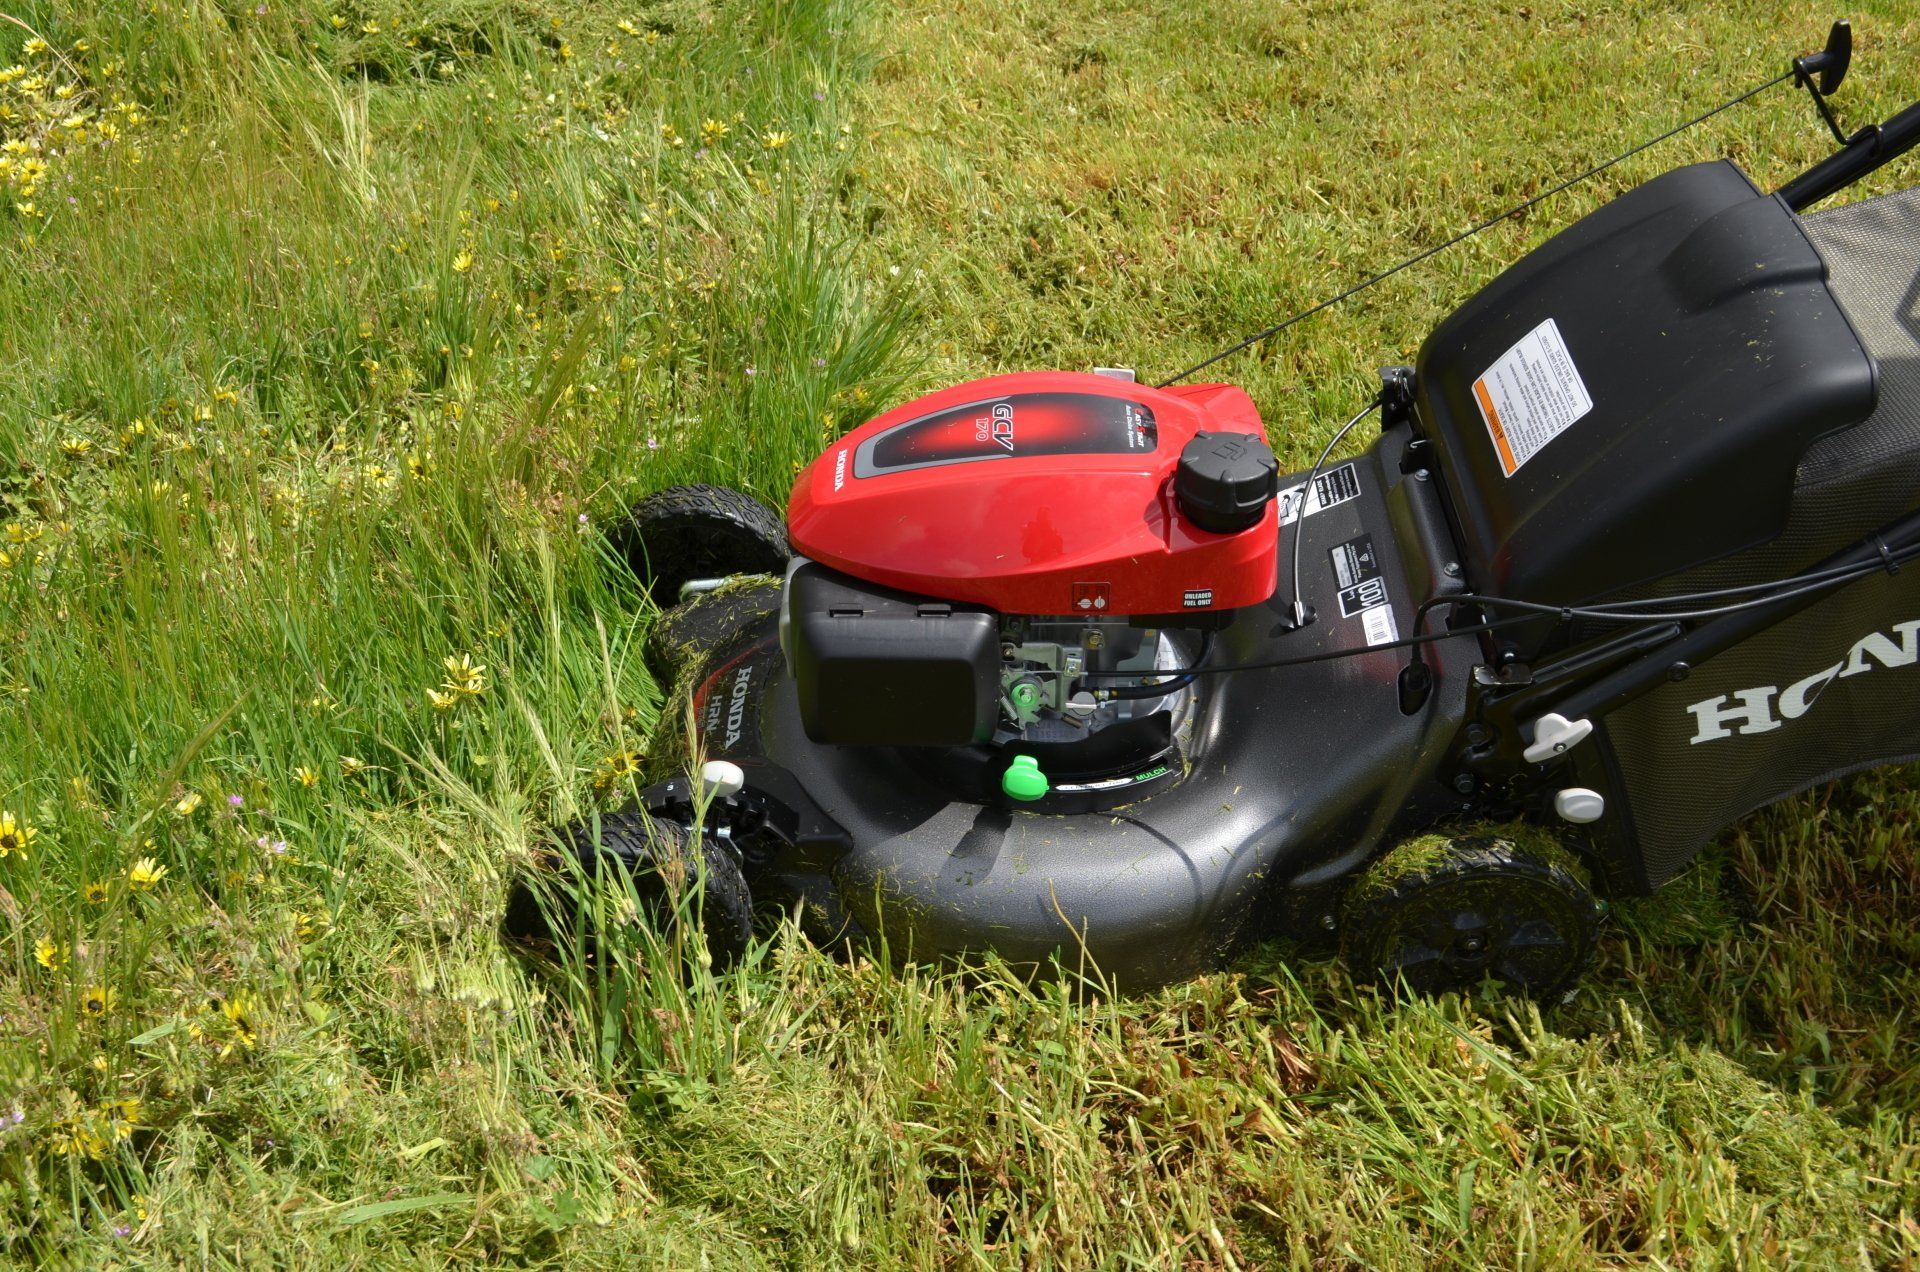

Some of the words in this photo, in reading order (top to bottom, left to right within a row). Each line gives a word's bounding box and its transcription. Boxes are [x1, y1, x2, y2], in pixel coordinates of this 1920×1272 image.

[975, 417, 989, 441] 170
[992, 403, 1014, 451] GCV
[1487, 408, 1501, 436] WARNING
[834, 449, 848, 492] HONDA
[1184, 591, 1211, 599] UNLEADED
[1197, 598, 1211, 606] ONLY
[1357, 579, 1384, 608] 100
[706, 695, 723, 731] HRN
[725, 666, 753, 749] HONDA
[1136, 767, 1167, 782] MULCH
